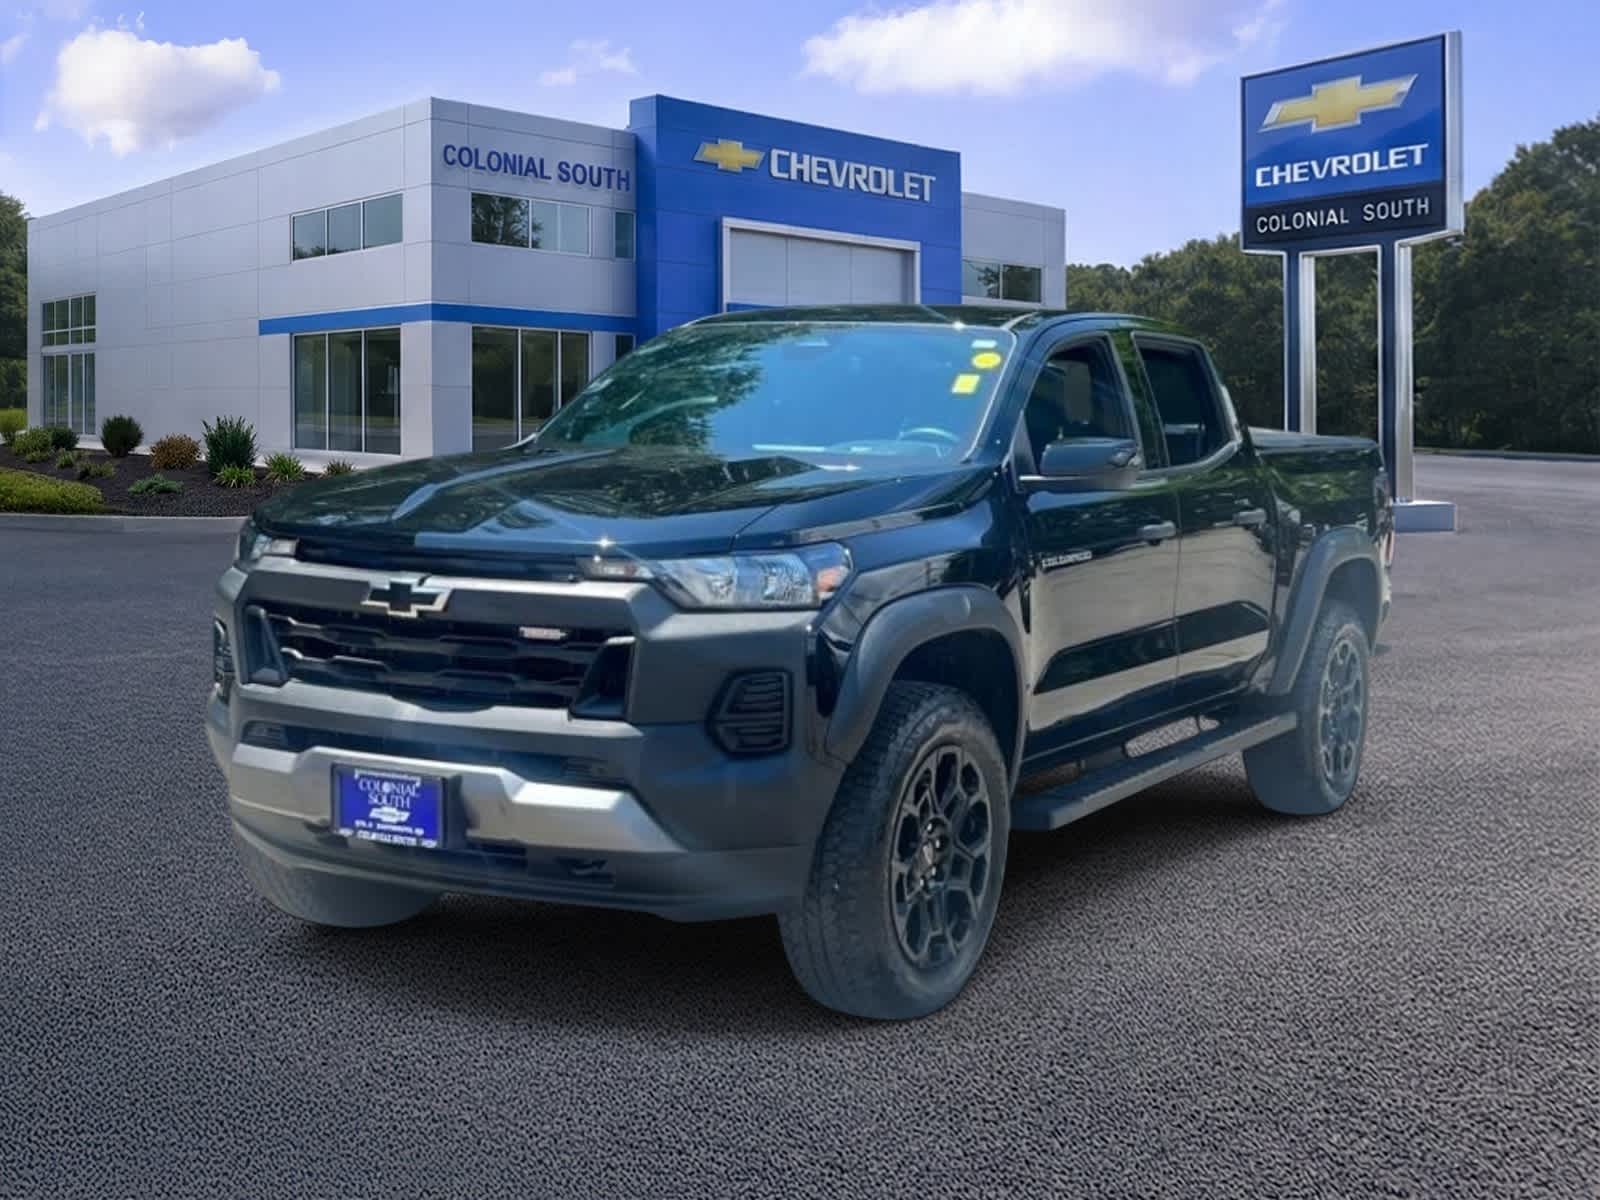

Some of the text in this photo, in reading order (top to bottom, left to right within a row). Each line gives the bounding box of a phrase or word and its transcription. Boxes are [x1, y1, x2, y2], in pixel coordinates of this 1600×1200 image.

[443, 144, 630, 192] COLONIAL SOUTH
[770, 148, 936, 202] CHEVROLET
[1255, 143, 1429, 187] CHEVROLET
[1257, 197, 1429, 234] COLONIAL SOUTH
[358, 778, 418, 798] COLONIAL
[368, 792, 410, 808] SOUTH
